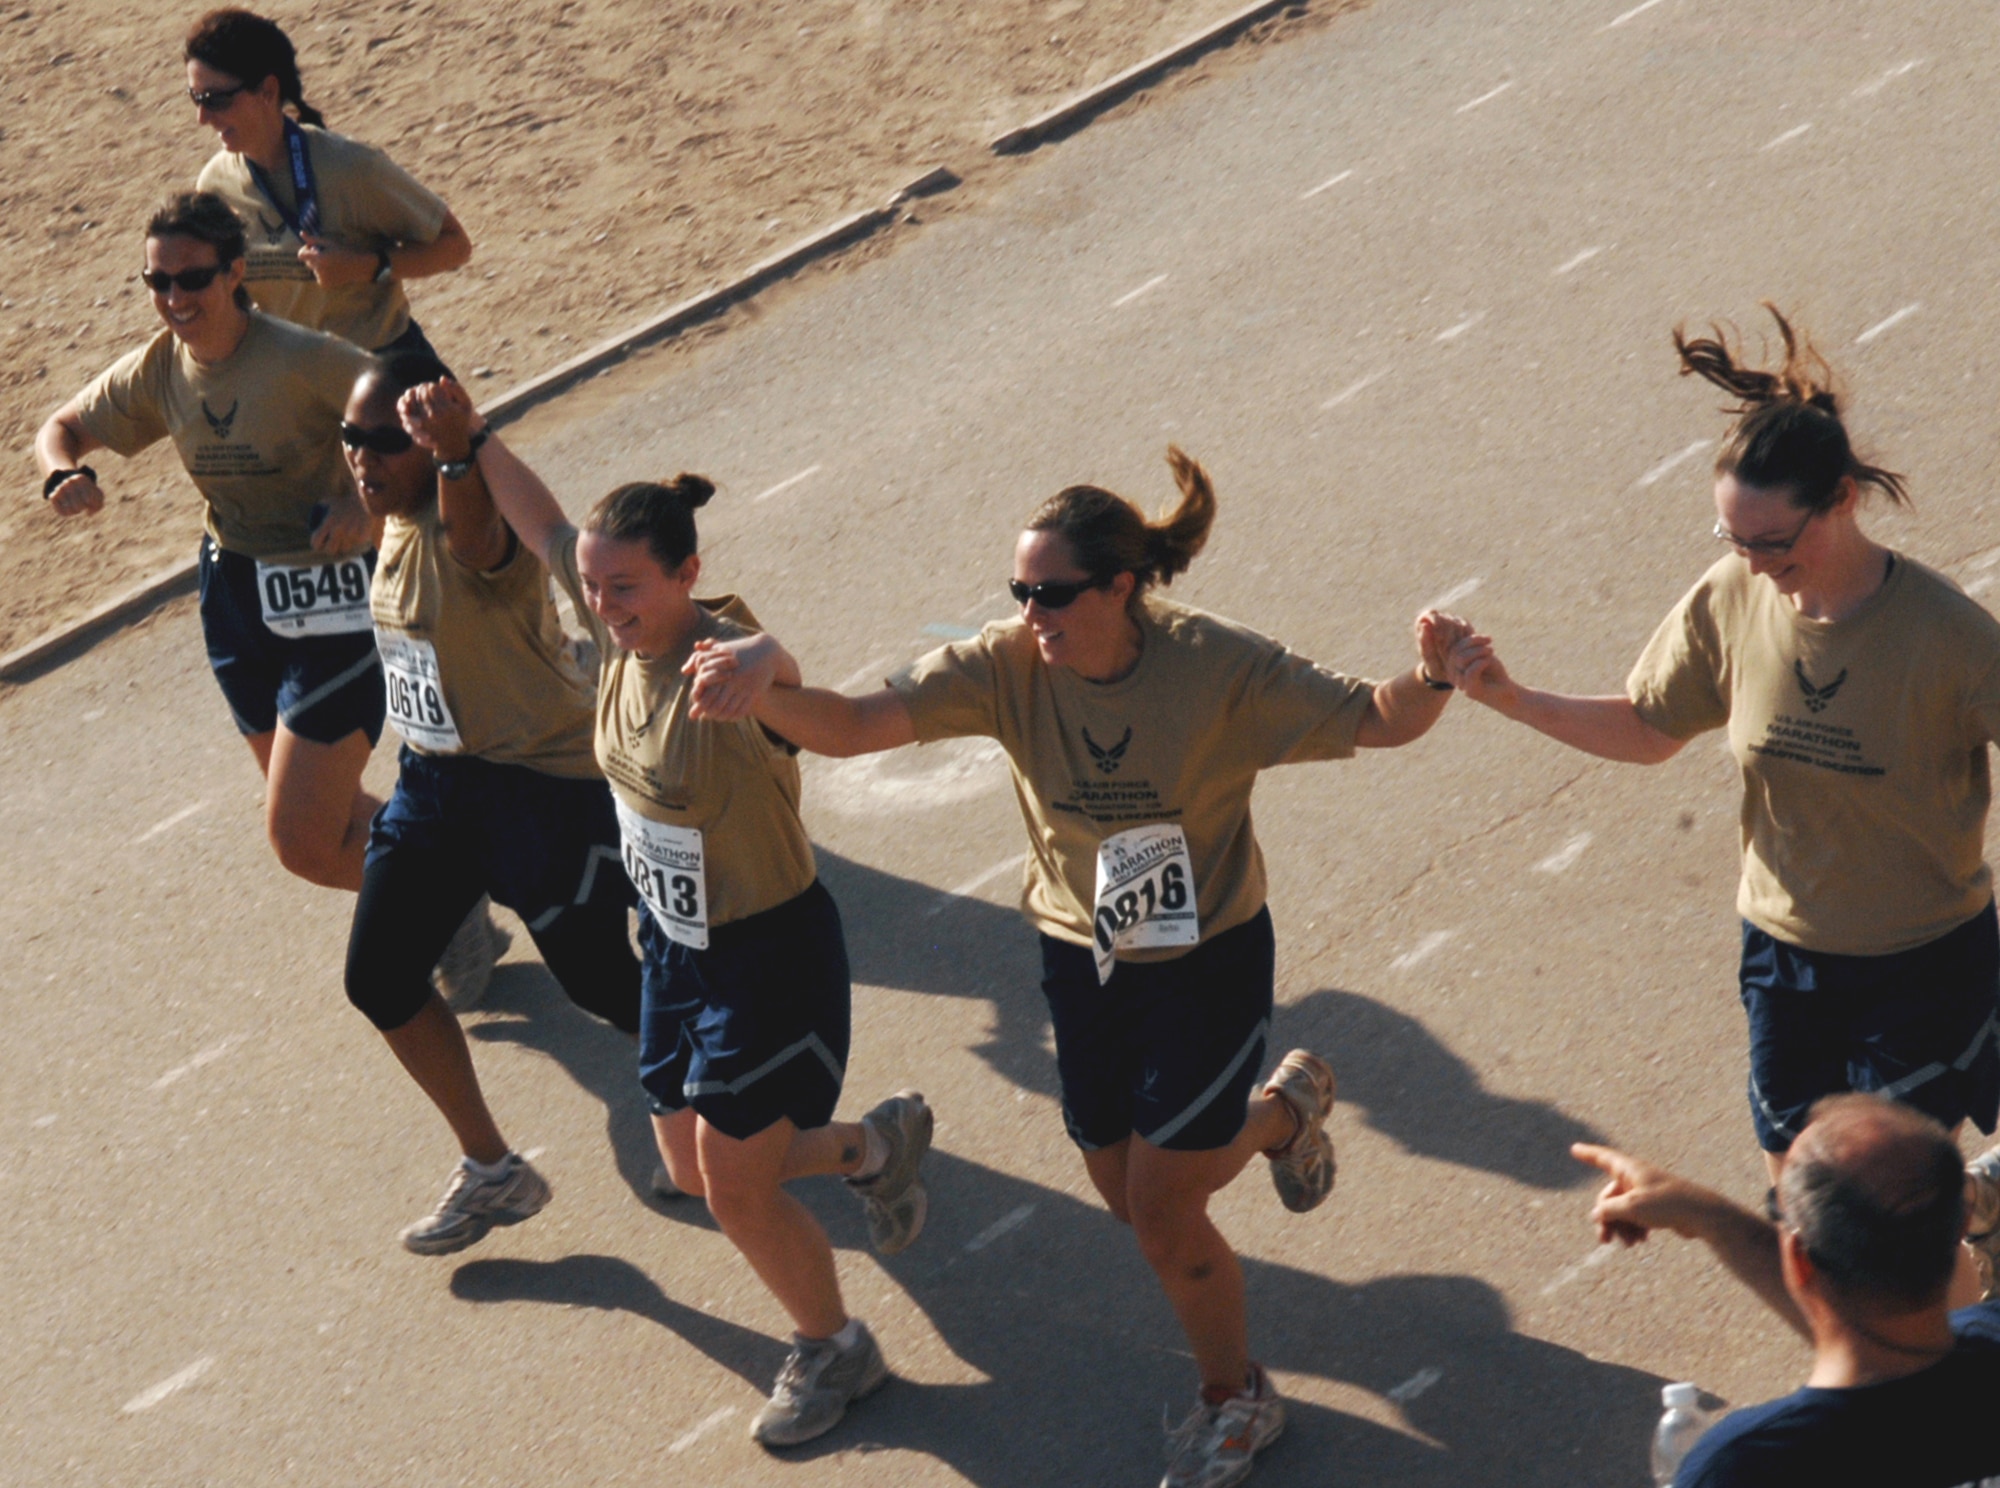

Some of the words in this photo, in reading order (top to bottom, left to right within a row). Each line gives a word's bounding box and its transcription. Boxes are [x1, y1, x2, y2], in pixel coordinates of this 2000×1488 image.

[265, 562, 365, 613] 0549
[389, 672, 445, 726] 0619
[1766, 724, 1861, 752] MARATHON
[626, 843, 699, 918] 0813
[1095, 863, 1187, 954] 0816
